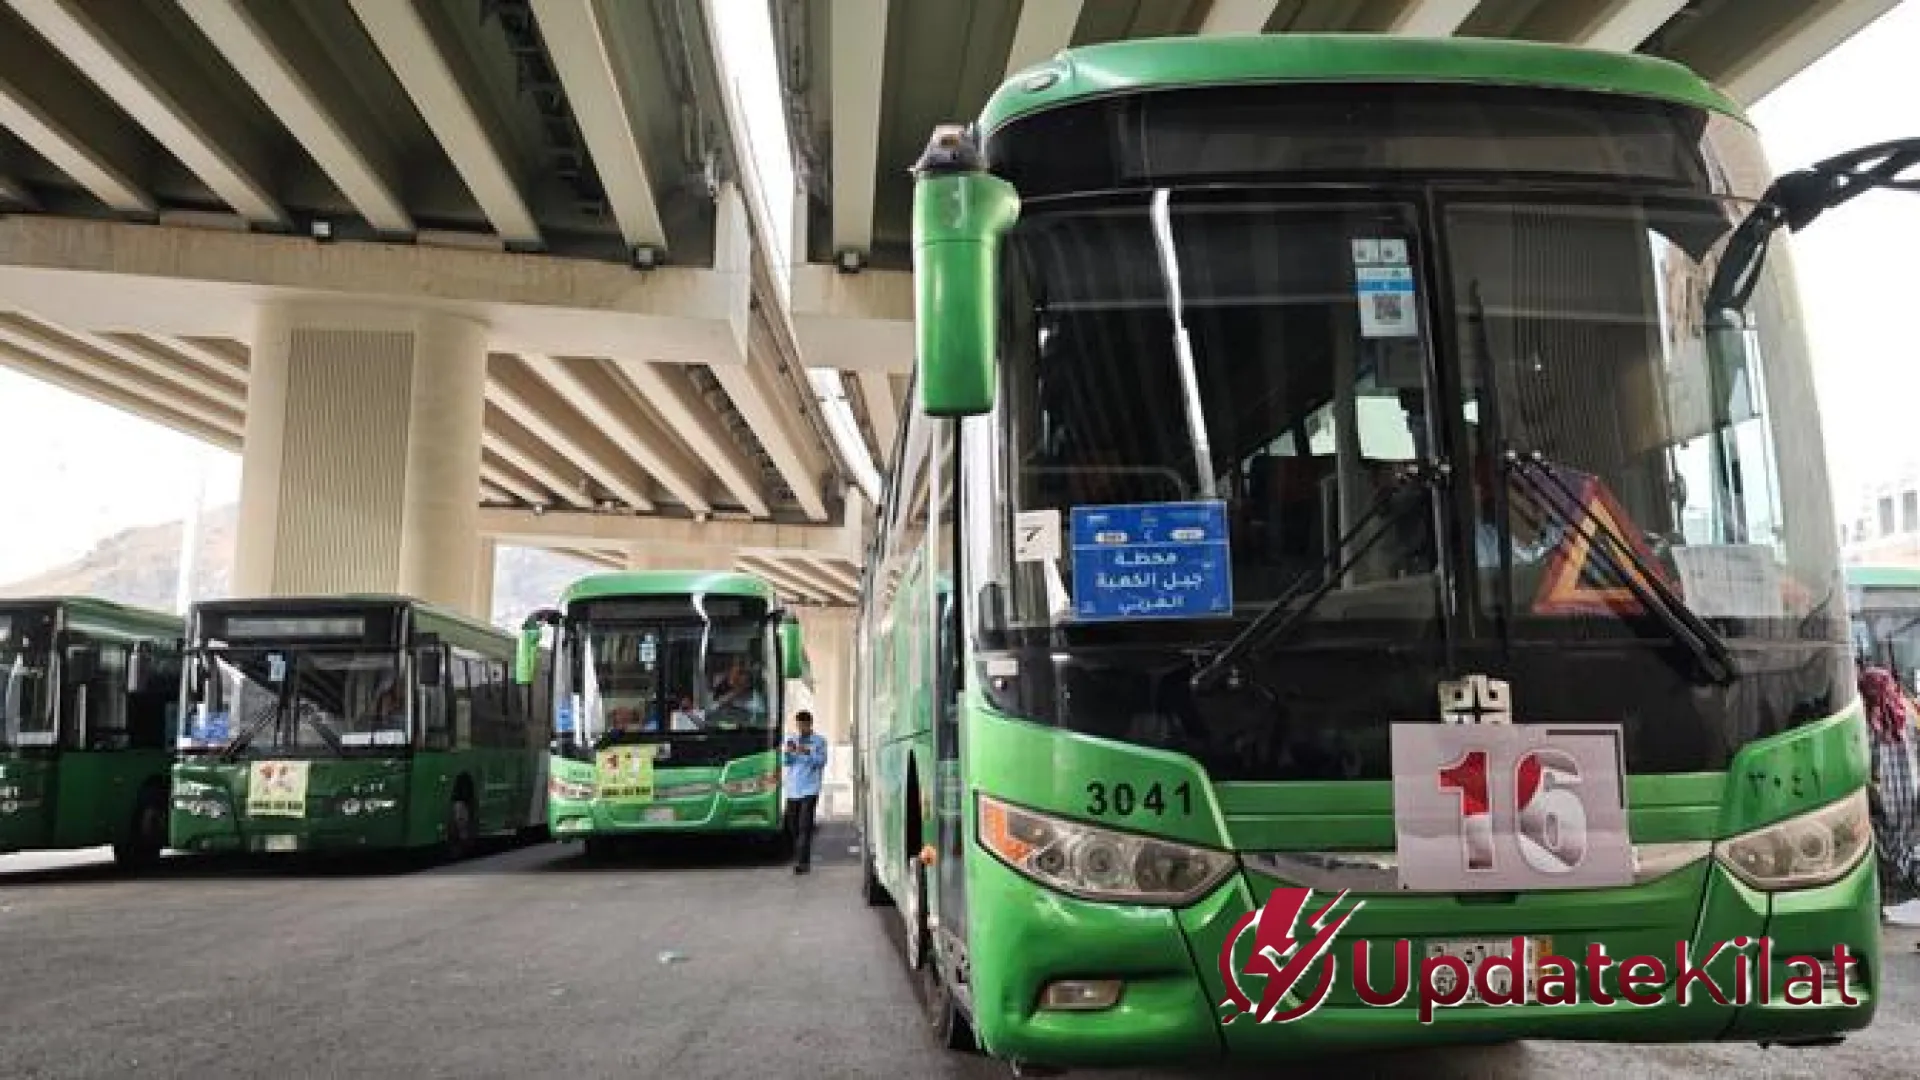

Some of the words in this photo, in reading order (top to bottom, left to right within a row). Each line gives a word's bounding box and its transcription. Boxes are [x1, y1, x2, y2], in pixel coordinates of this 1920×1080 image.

[1114, 551, 1178, 566] محطة
[1086, 780, 1191, 816] 3041
[1437, 749, 1587, 873] 16
